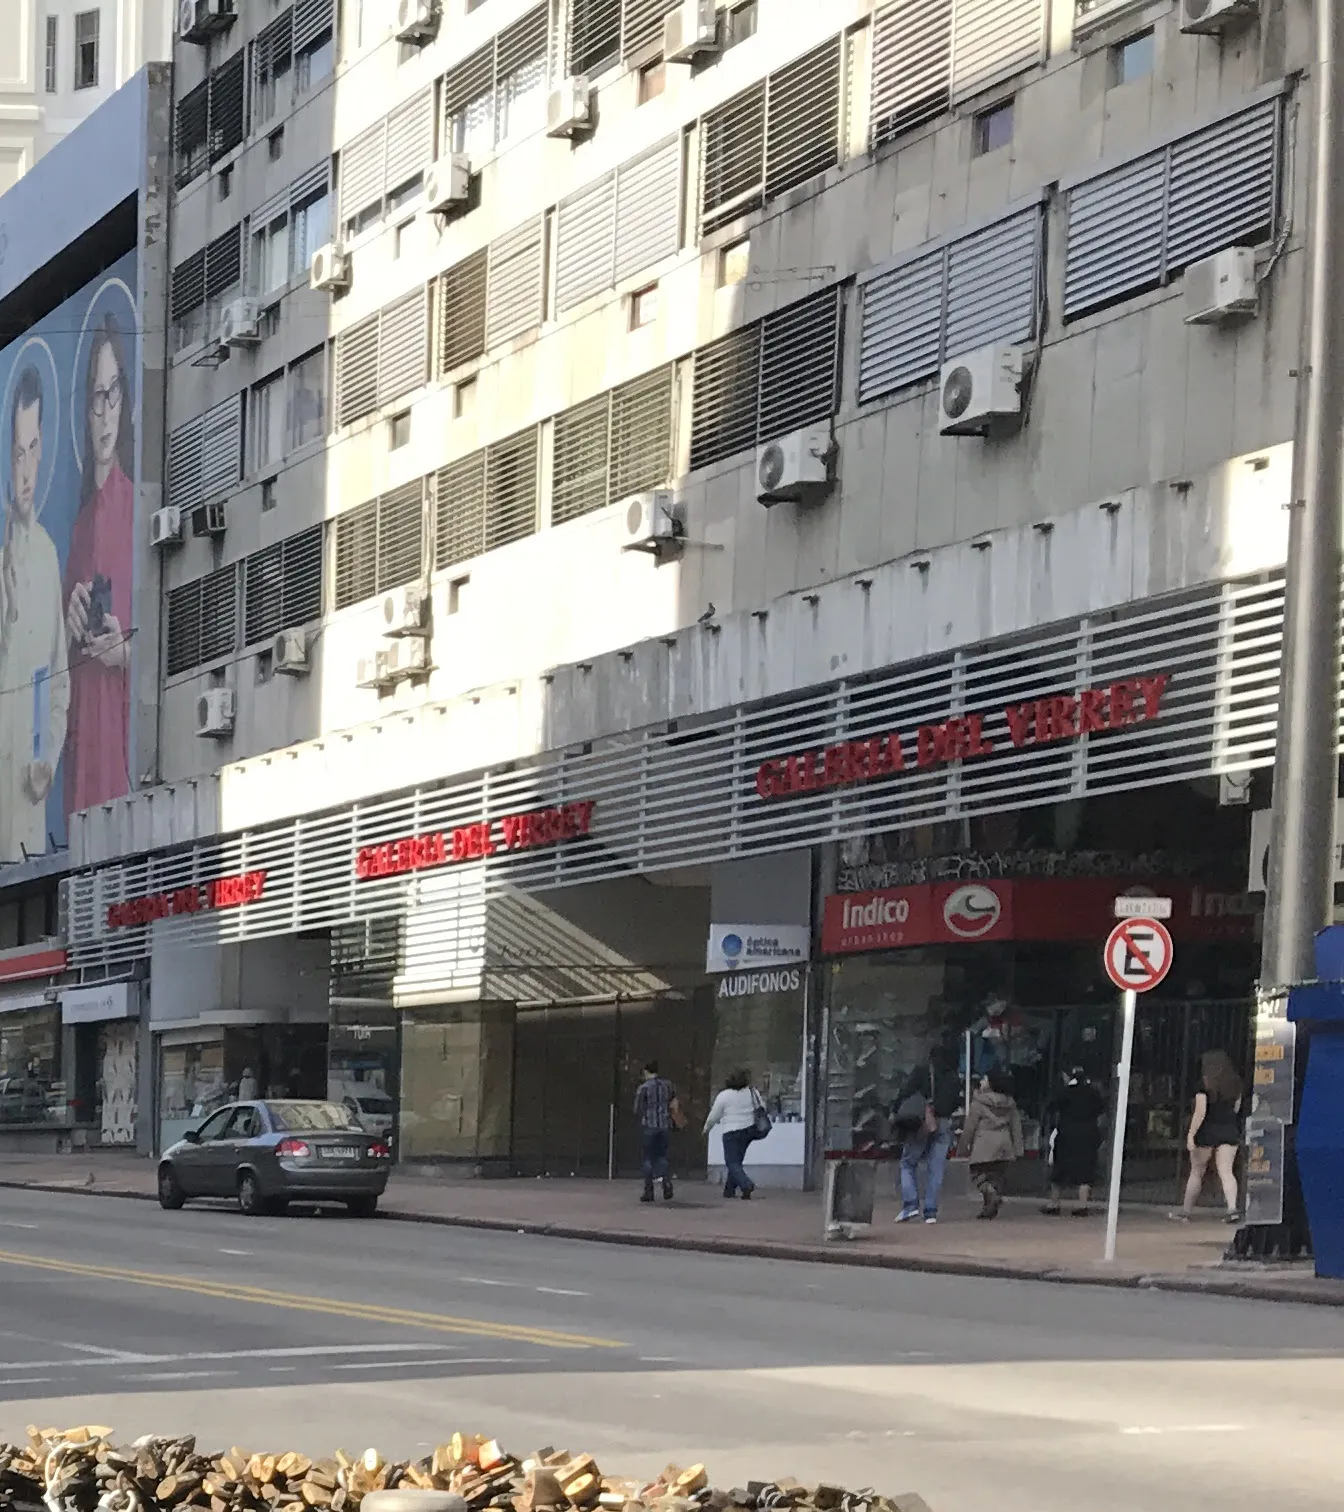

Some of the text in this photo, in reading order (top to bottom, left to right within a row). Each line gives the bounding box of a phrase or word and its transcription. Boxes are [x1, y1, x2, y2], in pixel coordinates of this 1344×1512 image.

[756, 674, 1171, 799] GALERIA DEL VIRREY
[356, 801, 595, 879] GALERIA DEL VIRREY
[718, 969, 800, 998] AUDIFONOS
